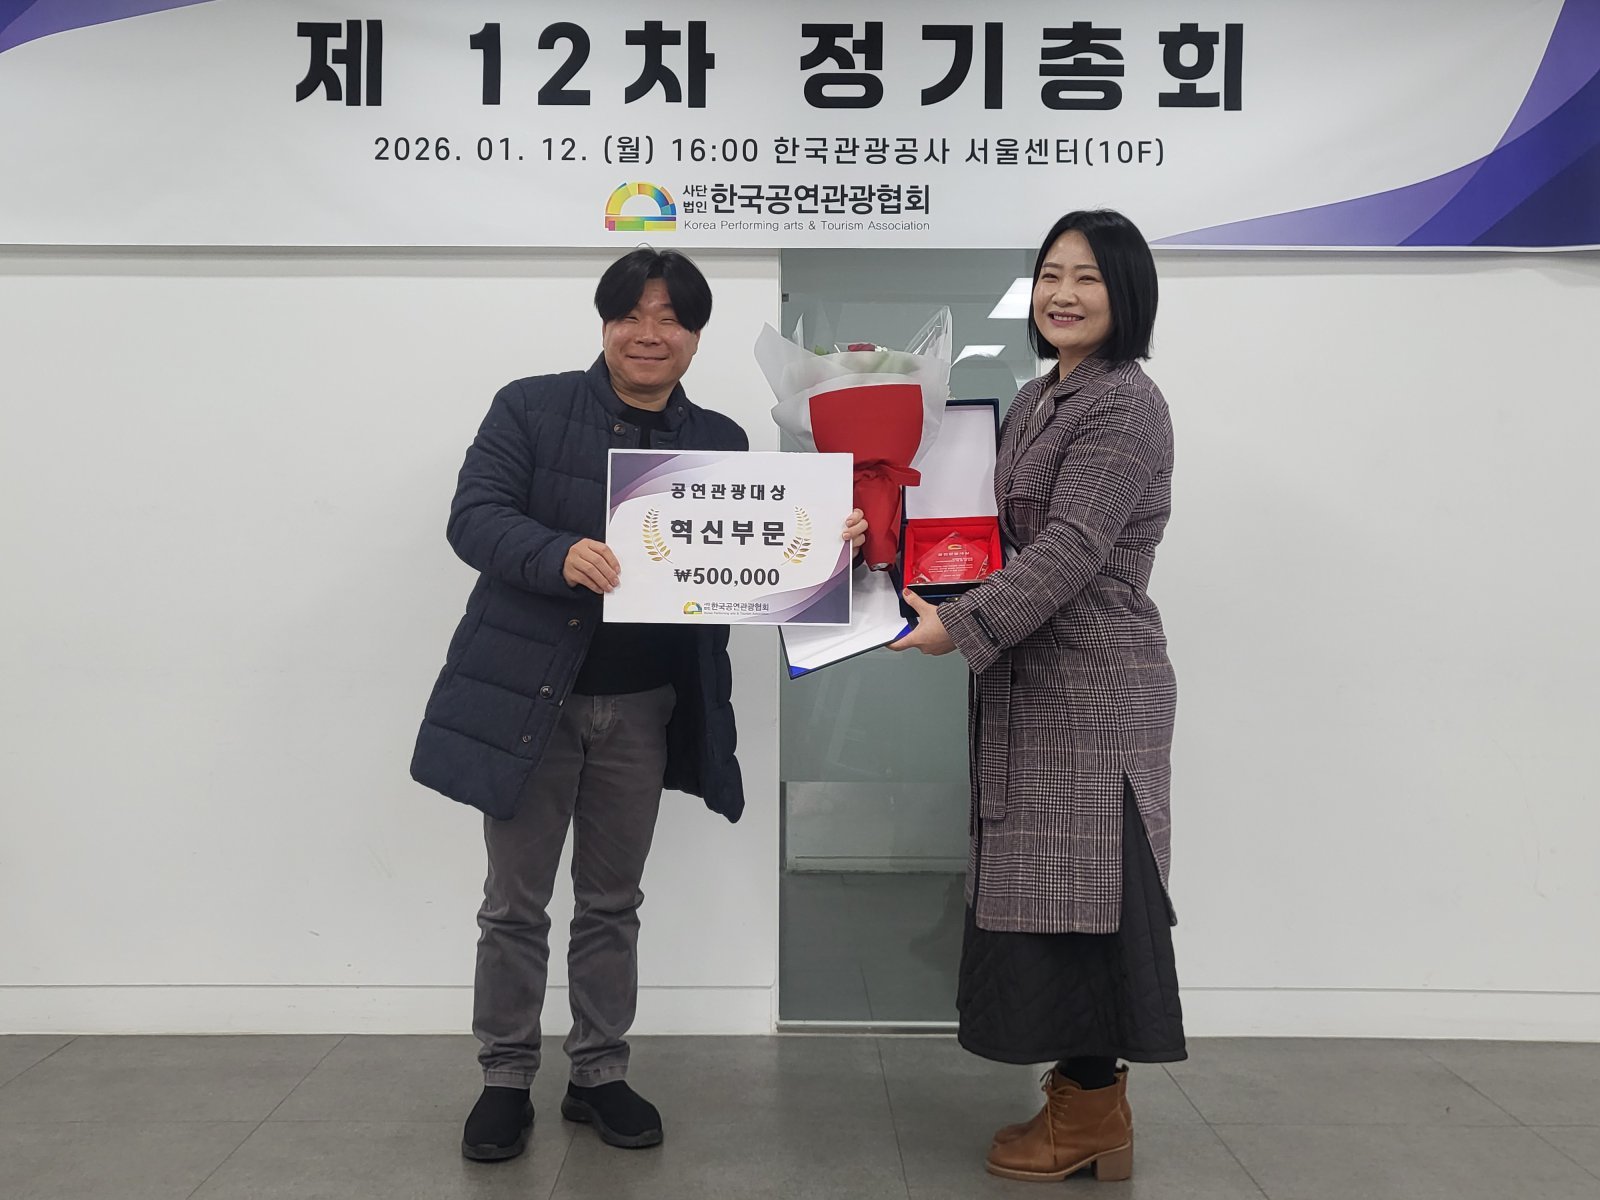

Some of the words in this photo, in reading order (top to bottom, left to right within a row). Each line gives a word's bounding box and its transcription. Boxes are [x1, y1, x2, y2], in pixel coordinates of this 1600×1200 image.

[295, 19, 383, 107] 제
[469, 21, 716, 109] 12차
[800, 21, 1244, 112] 정기총회
[374, 136, 461, 161] 2026.
[477, 136, 523, 161] 01.
[542, 137, 587, 161] 12.
[604, 135, 654, 165] (월)
[672, 138, 758, 163] 16:00
[773, 136, 950, 165] 한국관광공사
[965, 137, 1164, 167] 서울센터(10F)
[682, 184, 708, 198] 사단
[710, 183, 930, 215] 한국공연관광협회
[683, 200, 707, 214] 법인
[684, 220, 716, 230] Korea
[720, 220, 779, 232] Performing
[783, 221, 804, 231] arts
[808, 220, 816, 231] &
[820, 220, 864, 231] Tourism
[867, 220, 930, 231] Association
[670, 482, 786, 501] 공연관광대상
[670, 519, 786, 547] 혁신부문
[711, 602, 769, 612] 한국공연관광협회
